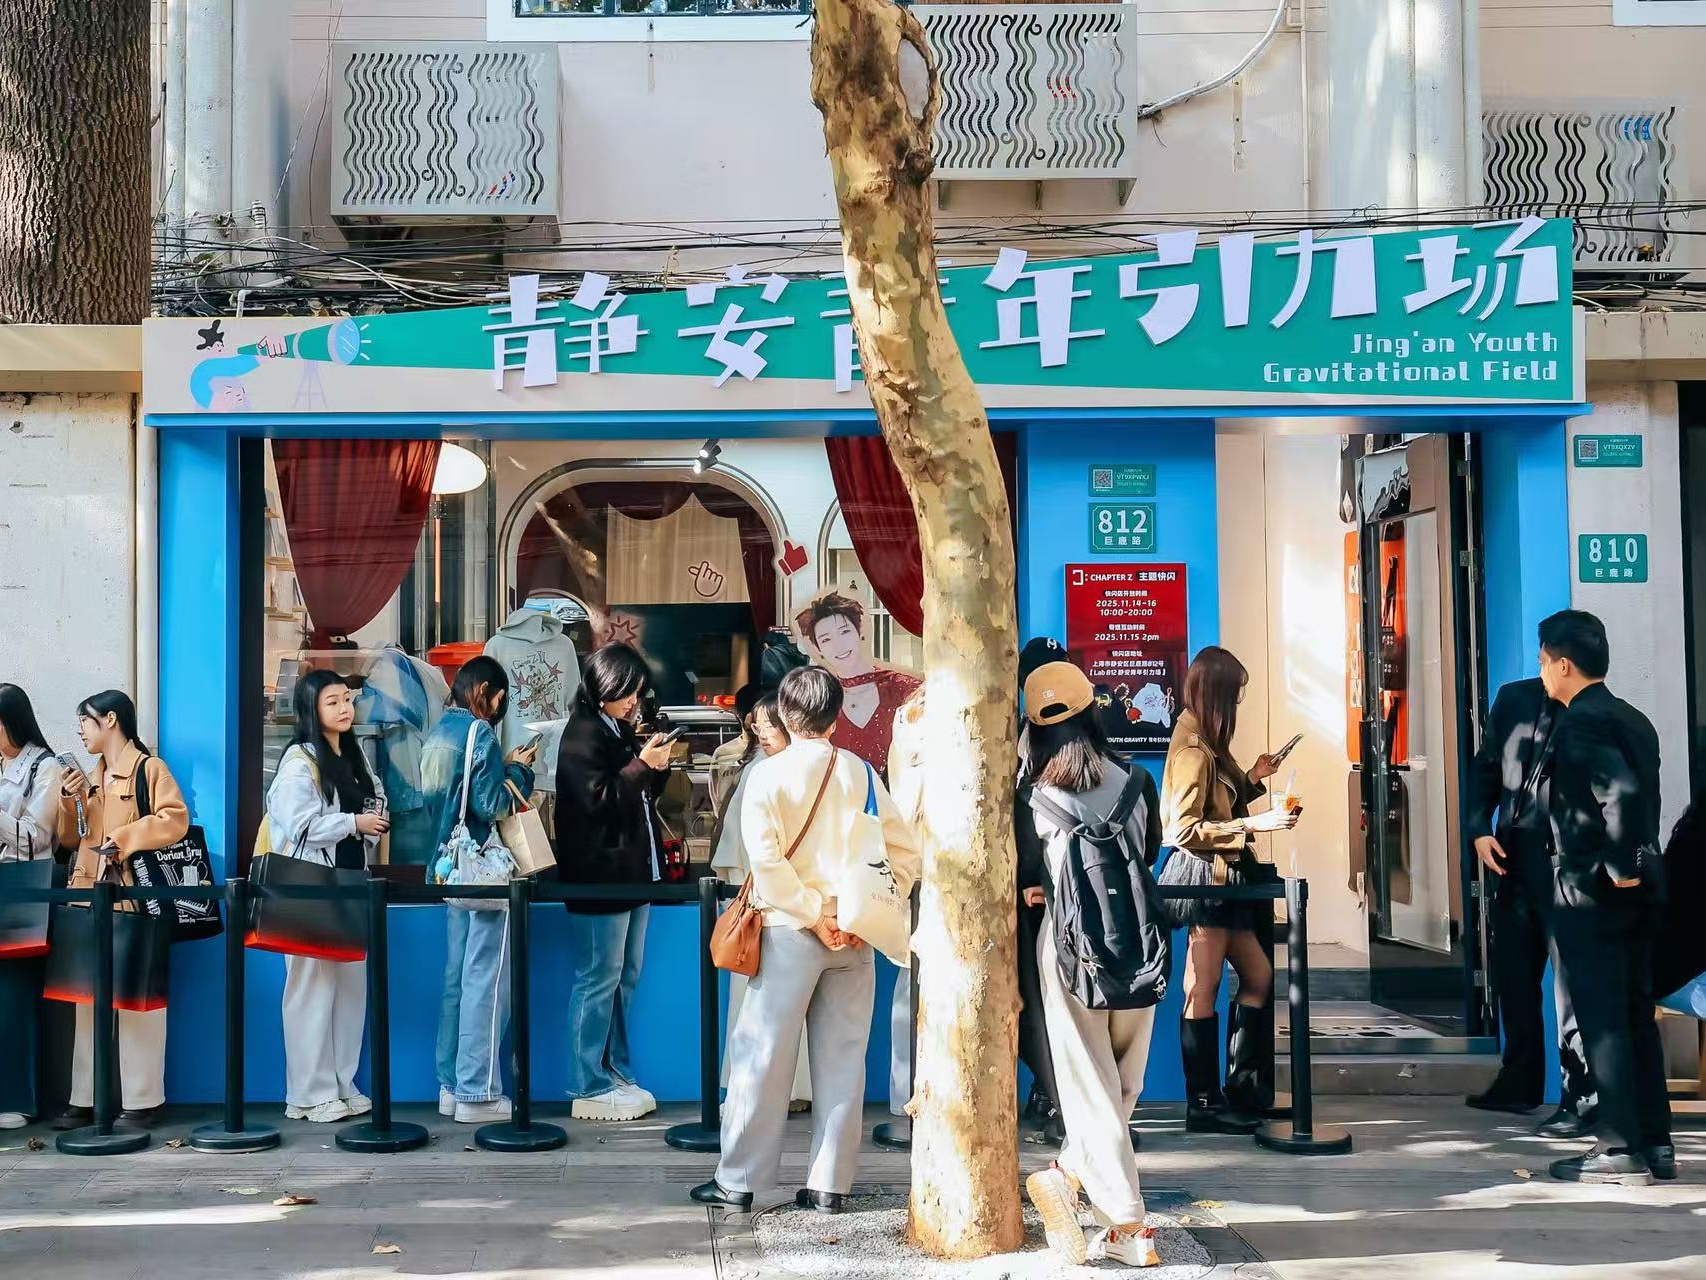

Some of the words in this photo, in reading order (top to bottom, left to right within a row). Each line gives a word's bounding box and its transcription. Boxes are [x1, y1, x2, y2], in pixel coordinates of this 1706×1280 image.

[1350, 330, 1455, 358] Jing'an
[1468, 331, 1557, 353] Youth
[1263, 361, 1469, 383] Gravitational
[1483, 360, 1557, 381] Field
[1098, 509, 1148, 534] 812
[1104, 536, 1142, 546] 巨鹿路
[1589, 537, 1638, 563] 810
[1139, 571, 1176, 581] 主题快闪
[1595, 568, 1634, 578] 巨鹿路
[1142, 634, 1160, 642] 2pm
[154, 850, 185, 861] Dorian
